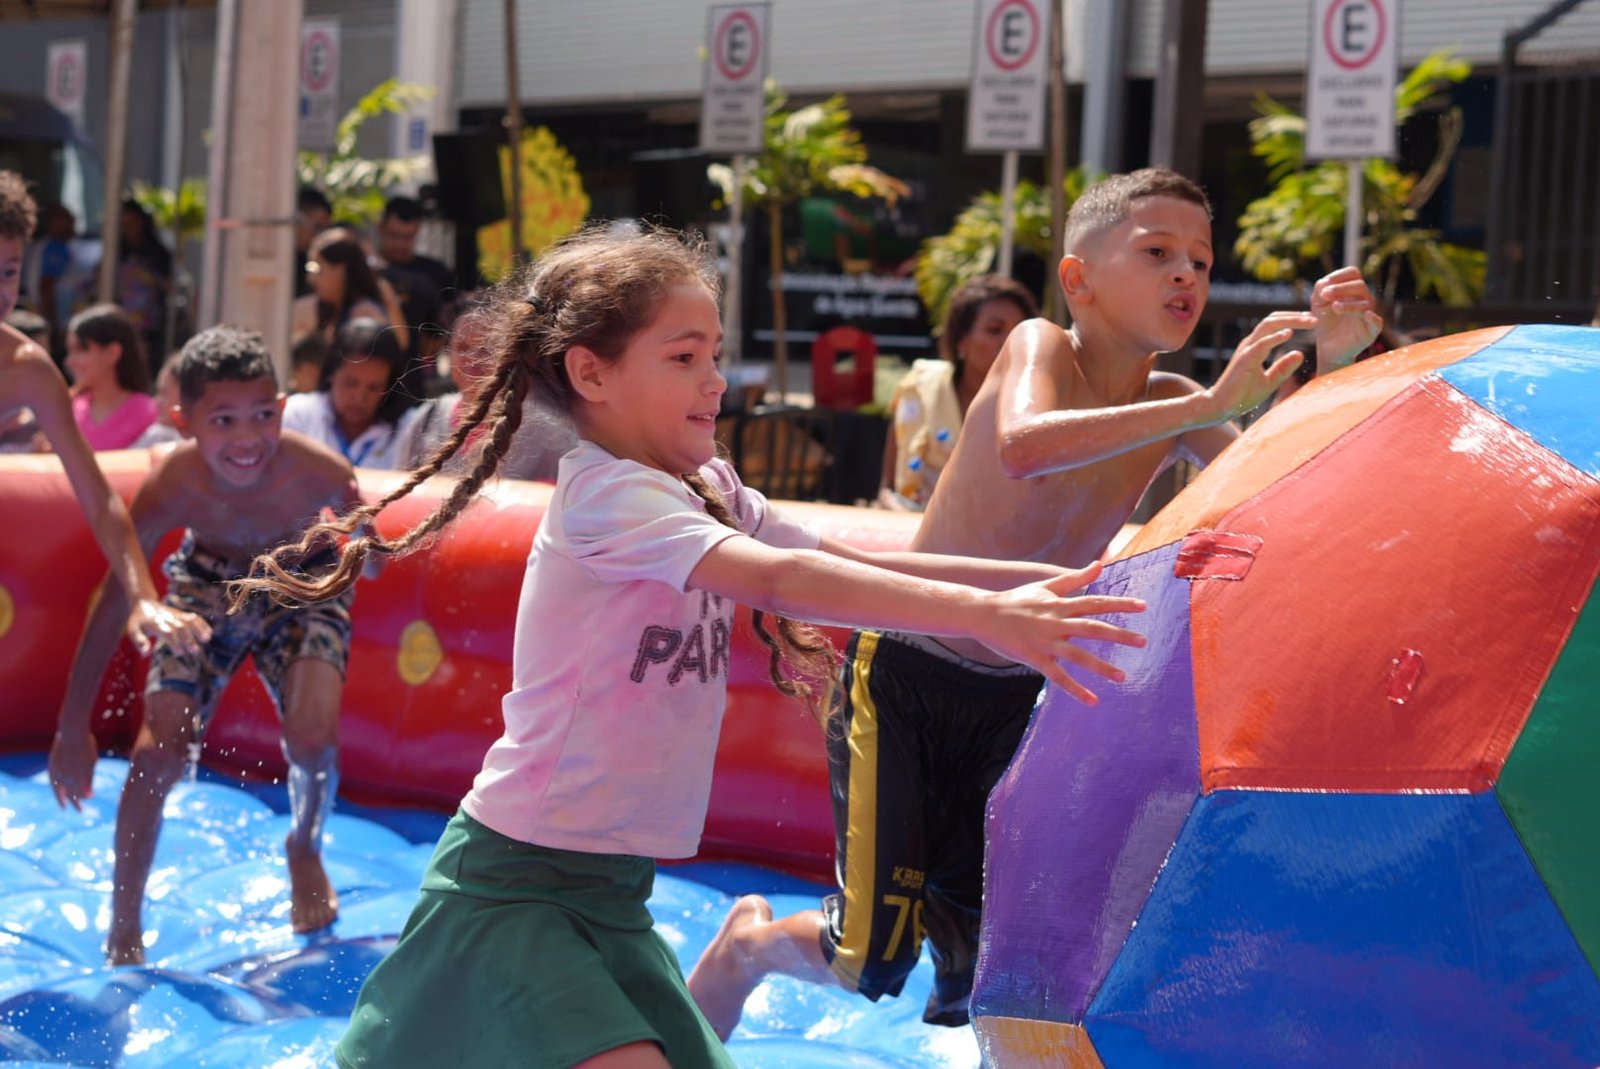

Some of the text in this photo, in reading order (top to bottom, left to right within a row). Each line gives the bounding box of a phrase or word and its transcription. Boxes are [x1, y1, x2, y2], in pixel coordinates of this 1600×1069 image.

[727, 24, 747, 66] E
[1002, 10, 1023, 55] E
[1343, 3, 1367, 52] E
